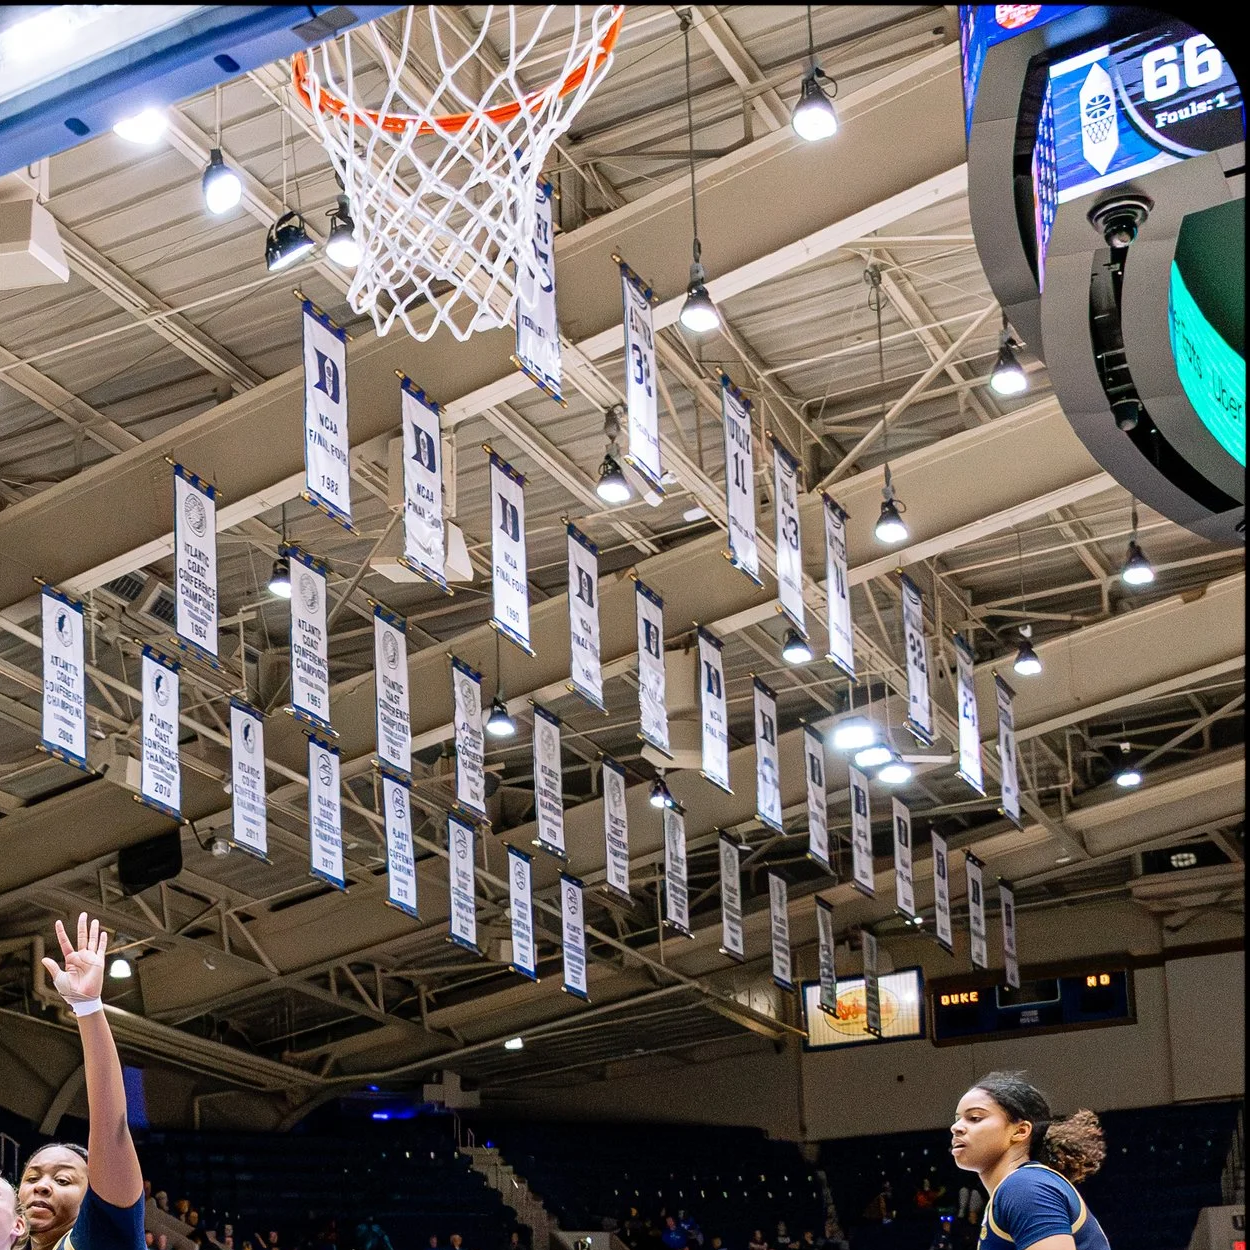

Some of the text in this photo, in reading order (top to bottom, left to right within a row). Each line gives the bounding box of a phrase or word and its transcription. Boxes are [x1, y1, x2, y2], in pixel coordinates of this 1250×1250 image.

[1142, 33, 1223, 102] 66
[319, 412, 339, 437] NCAA
[309, 428, 330, 455] FINAL
[416, 482, 435, 504] NCAA
[941, 991, 978, 1006] DUKE
